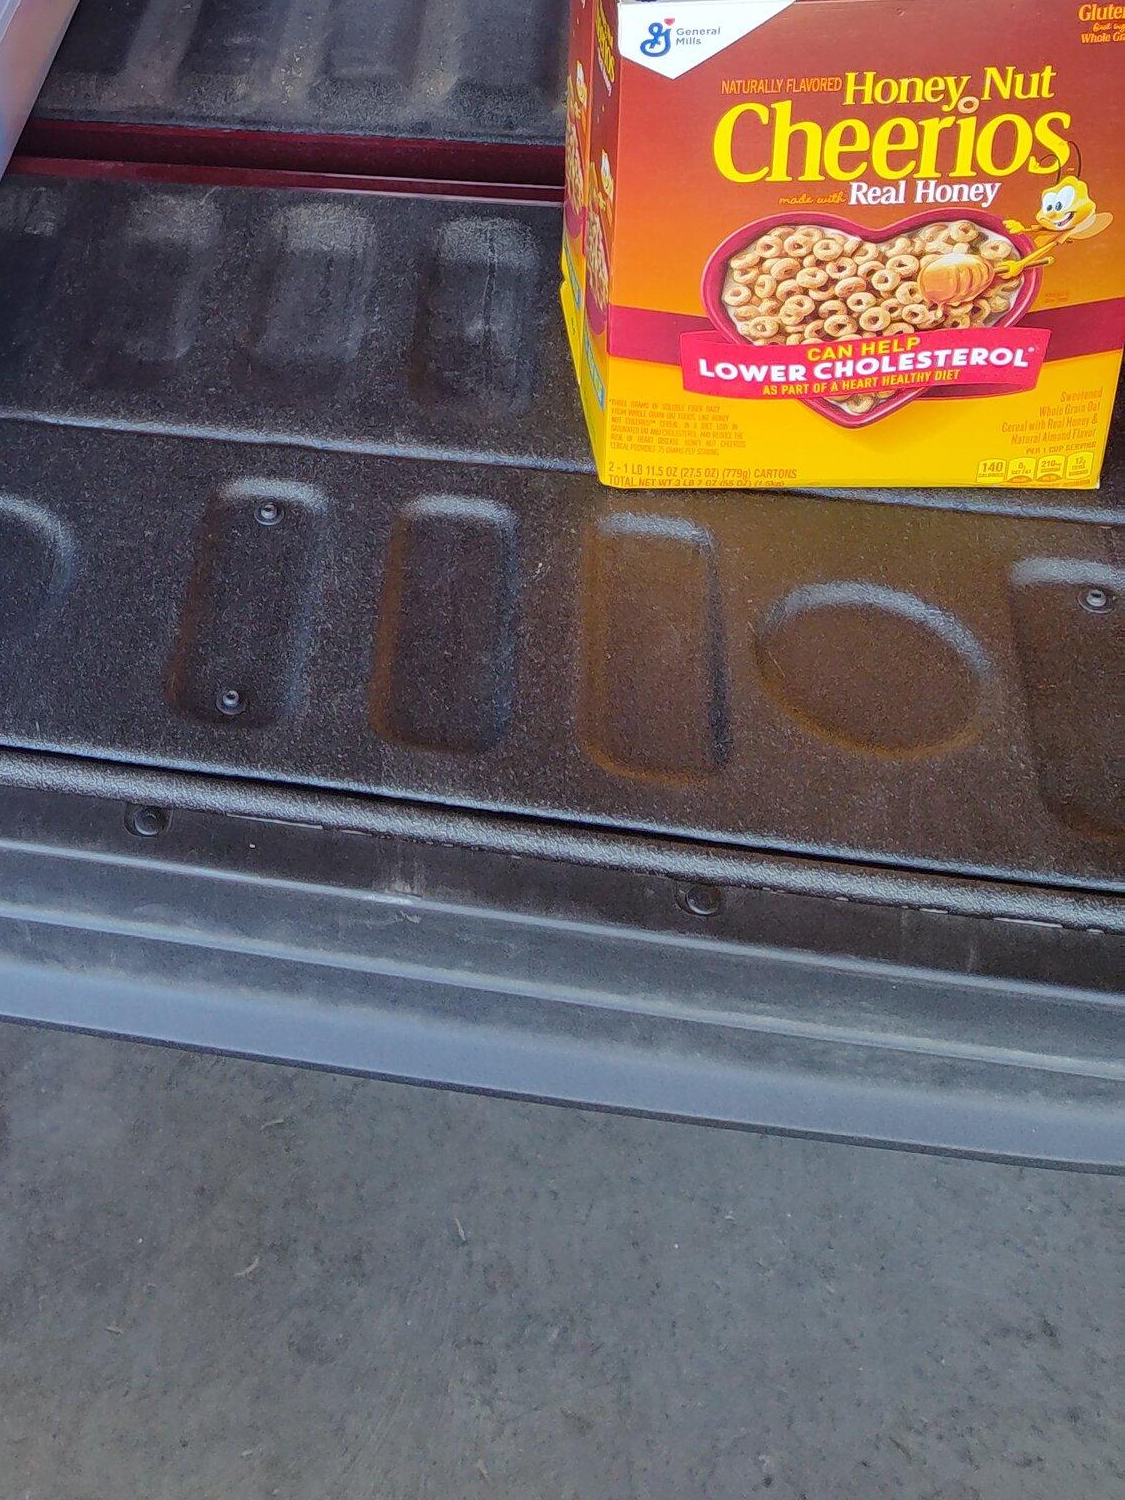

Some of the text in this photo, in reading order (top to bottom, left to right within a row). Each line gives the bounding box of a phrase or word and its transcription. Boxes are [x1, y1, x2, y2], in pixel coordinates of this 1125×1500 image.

[1078, 3, 1125, 22] Glute
[675, 26, 721, 37] General
[1080, 32, 1111, 44] Whole
[675, 36, 703, 46] Mills
[721, 64, 1057, 109] NATURALLY FLAVORED Honey Nut
[713, 99, 1072, 183] Cheerios
[779, 179, 1002, 208] made with Real Honey
[807, 336, 922, 363] CAN HELP
[698, 346, 1030, 383] LOWER CHOLESTEROL
[763, 368, 962, 396] AS PART OF A HEART HEALTHY DIET
[1061, 387, 1103, 402] Sweetened
[1039, 401, 1101, 417] Whole Grain Oat
[1002, 416, 1090, 433] Cereal with Real Honey
[1011, 428, 1096, 445] Natural Almond Flavor
[609, 461, 797, 480] 2 LB 11.5 OZ (27.5 OZ) (779g) CARTONS
[981, 461, 1004, 473] 140
[608, 474, 636, 487] TOTAL
[639, 478, 655, 487] NET
